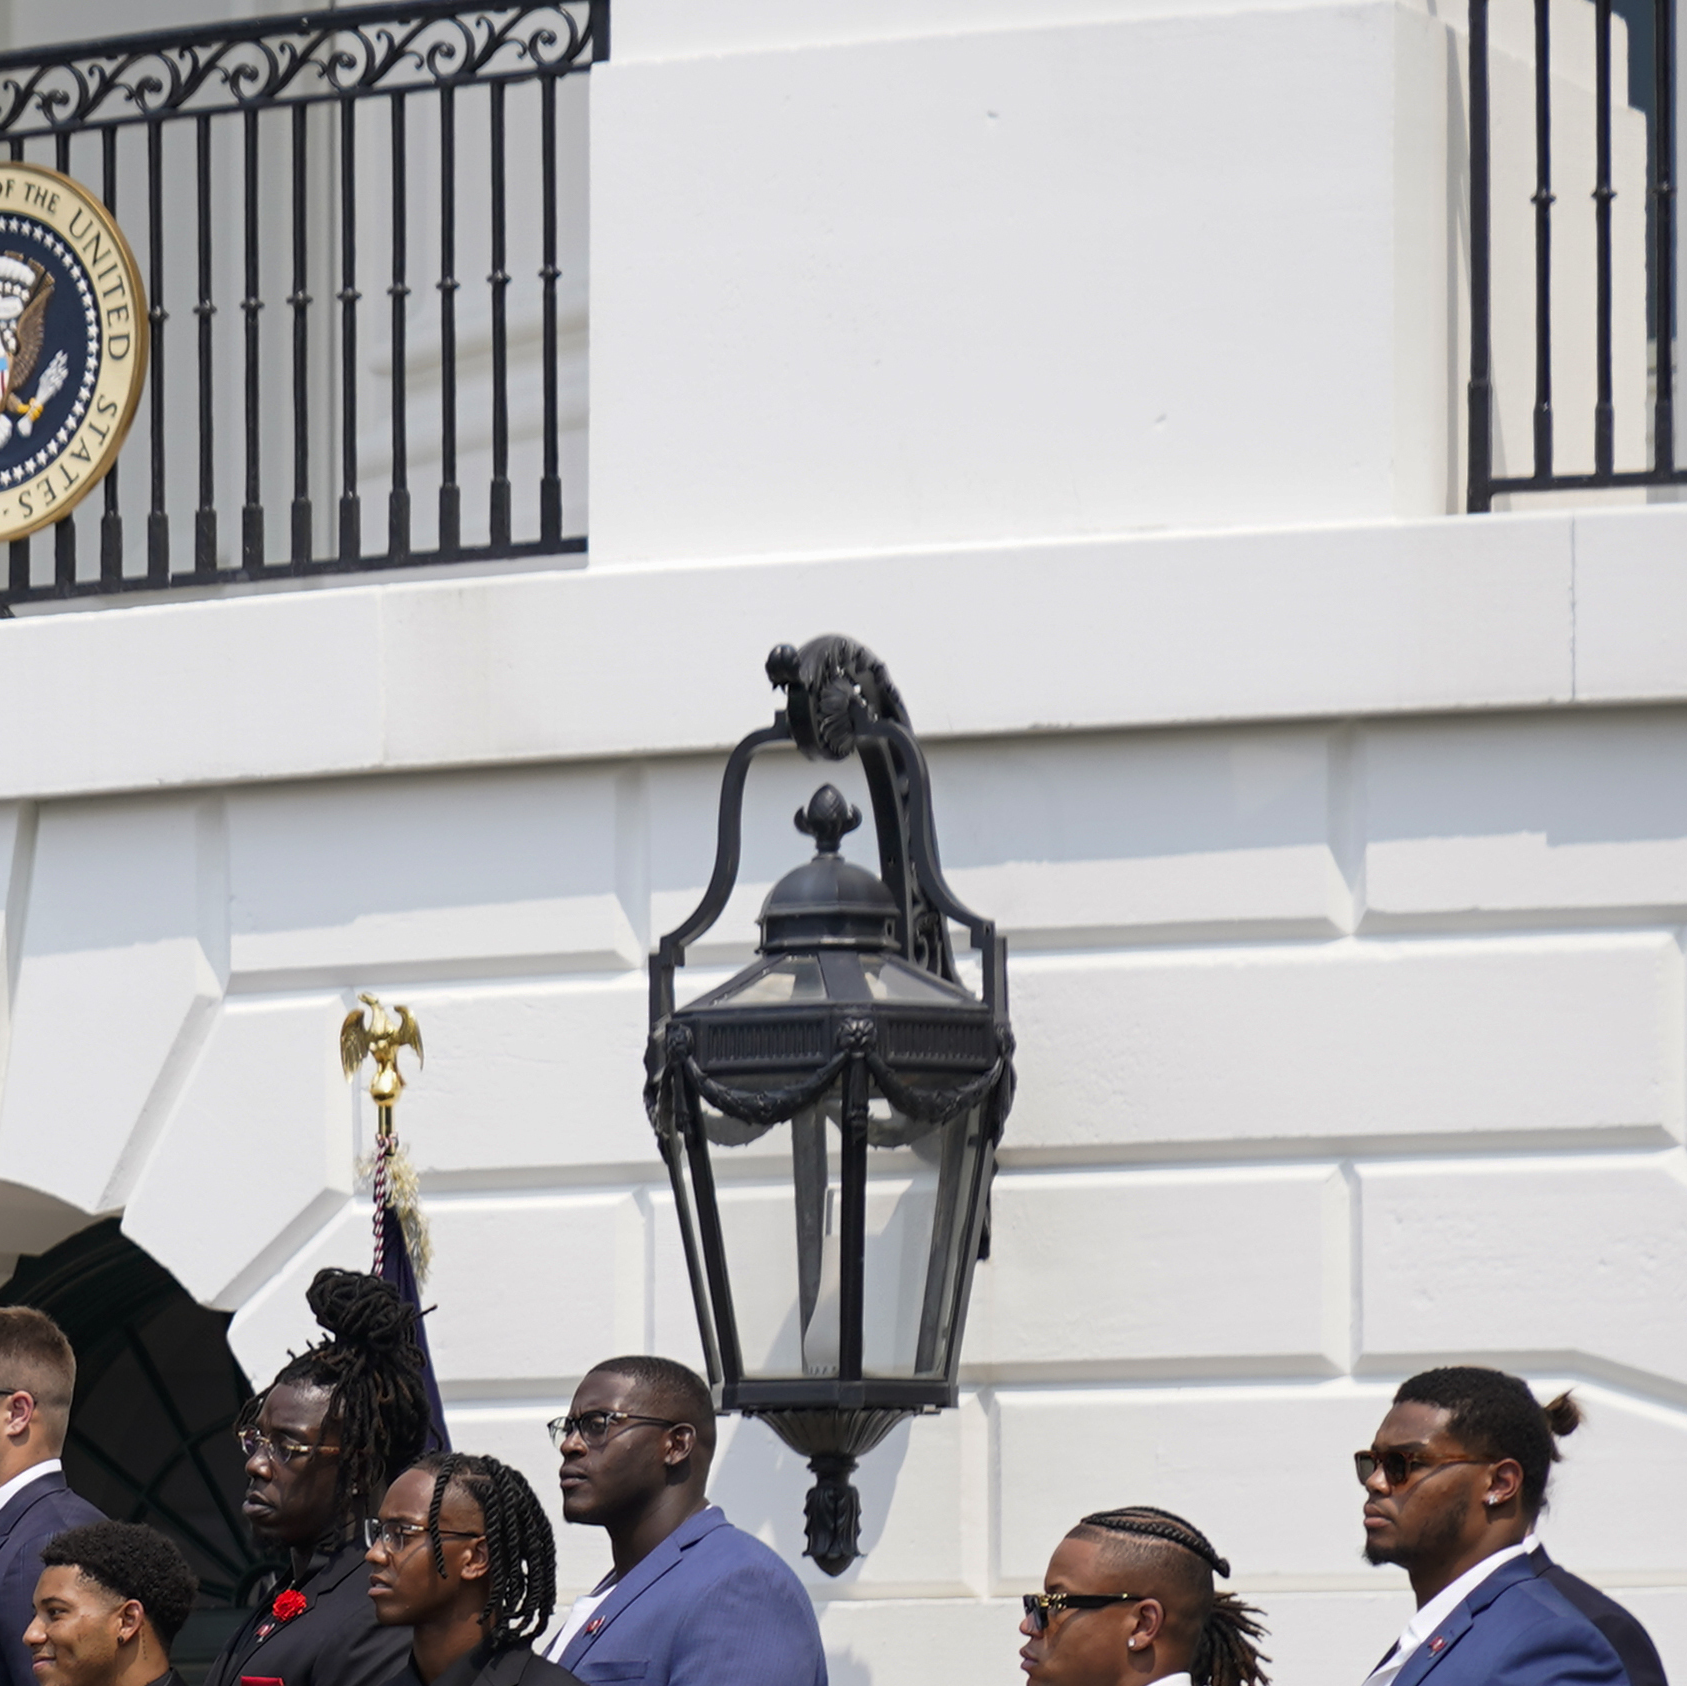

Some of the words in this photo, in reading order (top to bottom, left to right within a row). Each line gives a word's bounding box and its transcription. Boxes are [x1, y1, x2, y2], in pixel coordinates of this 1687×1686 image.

[24, 182, 60, 213] THE
[68, 207, 131, 361] UNITED
[19, 395, 117, 519] STATES
